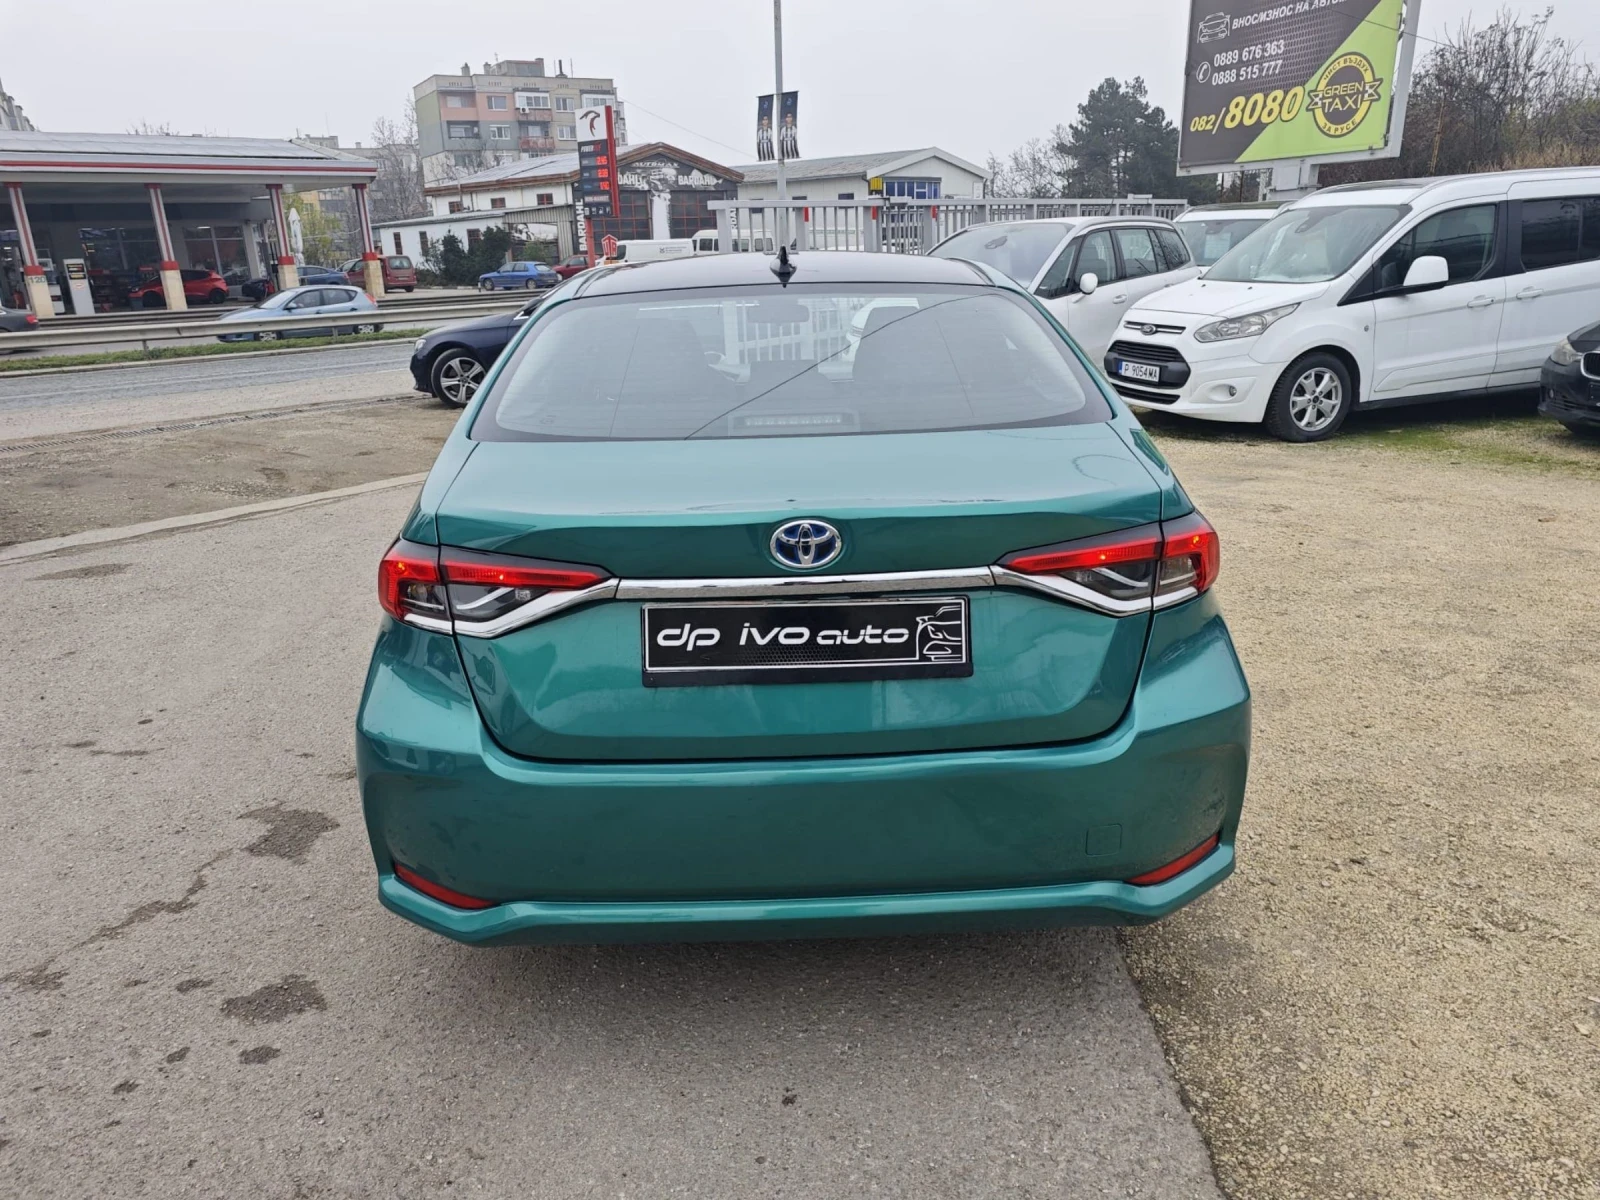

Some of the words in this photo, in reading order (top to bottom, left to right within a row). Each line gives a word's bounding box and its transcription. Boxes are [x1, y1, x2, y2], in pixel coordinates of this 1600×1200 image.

[1232, 4, 1293, 30] ВНОС/ИЗНОС
[1295, 1, 1309, 13] НА
[1213, 49, 1239, 67] 0889
[1241, 44, 1262, 61] 676
[1264, 39, 1285, 57] 363
[1212, 69, 1237, 86] 0888
[1239, 64, 1260, 81] 515
[1262, 59, 1283, 77] 777
[1323, 80, 1364, 97] GREEN
[1322, 94, 1362, 113] TAXI
[1322, 122, 1332, 134] ЗА
[1334, 118, 1357, 134] РУСЕ
[618, 174, 640, 185] DAHL
[575, 199, 588, 252] BARDAHL
[656, 623, 721, 652] dp
[739, 622, 810, 646] ivo
[816, 624, 909, 646] auto
